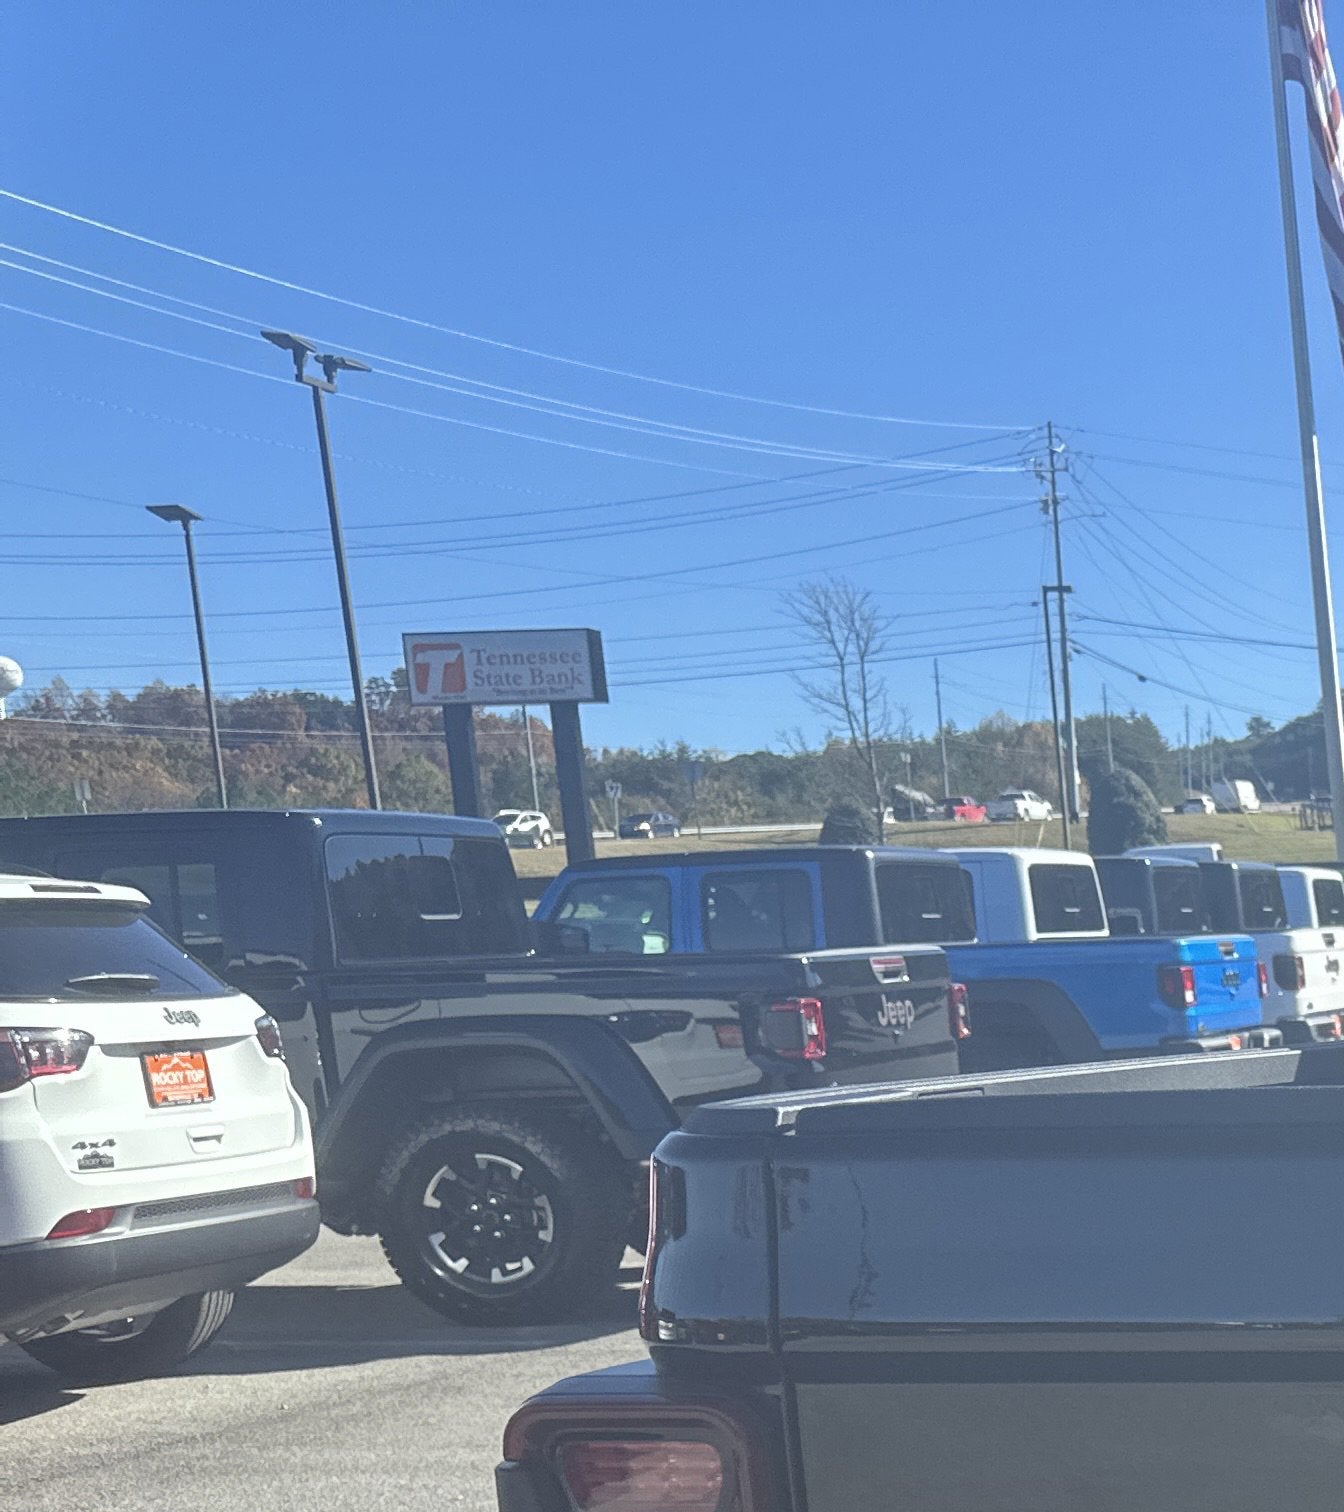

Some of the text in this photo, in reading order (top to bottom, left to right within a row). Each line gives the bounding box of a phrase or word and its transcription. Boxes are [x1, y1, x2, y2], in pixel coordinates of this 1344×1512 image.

[470, 649, 583, 666] Tennessee
[473, 668, 584, 687] State Bank
[163, 1007, 200, 1028] Jeep
[877, 993, 915, 1030] Jeep
[151, 1069, 205, 1086] ROCKY TOP
[72, 1139, 116, 1150] 4x4
